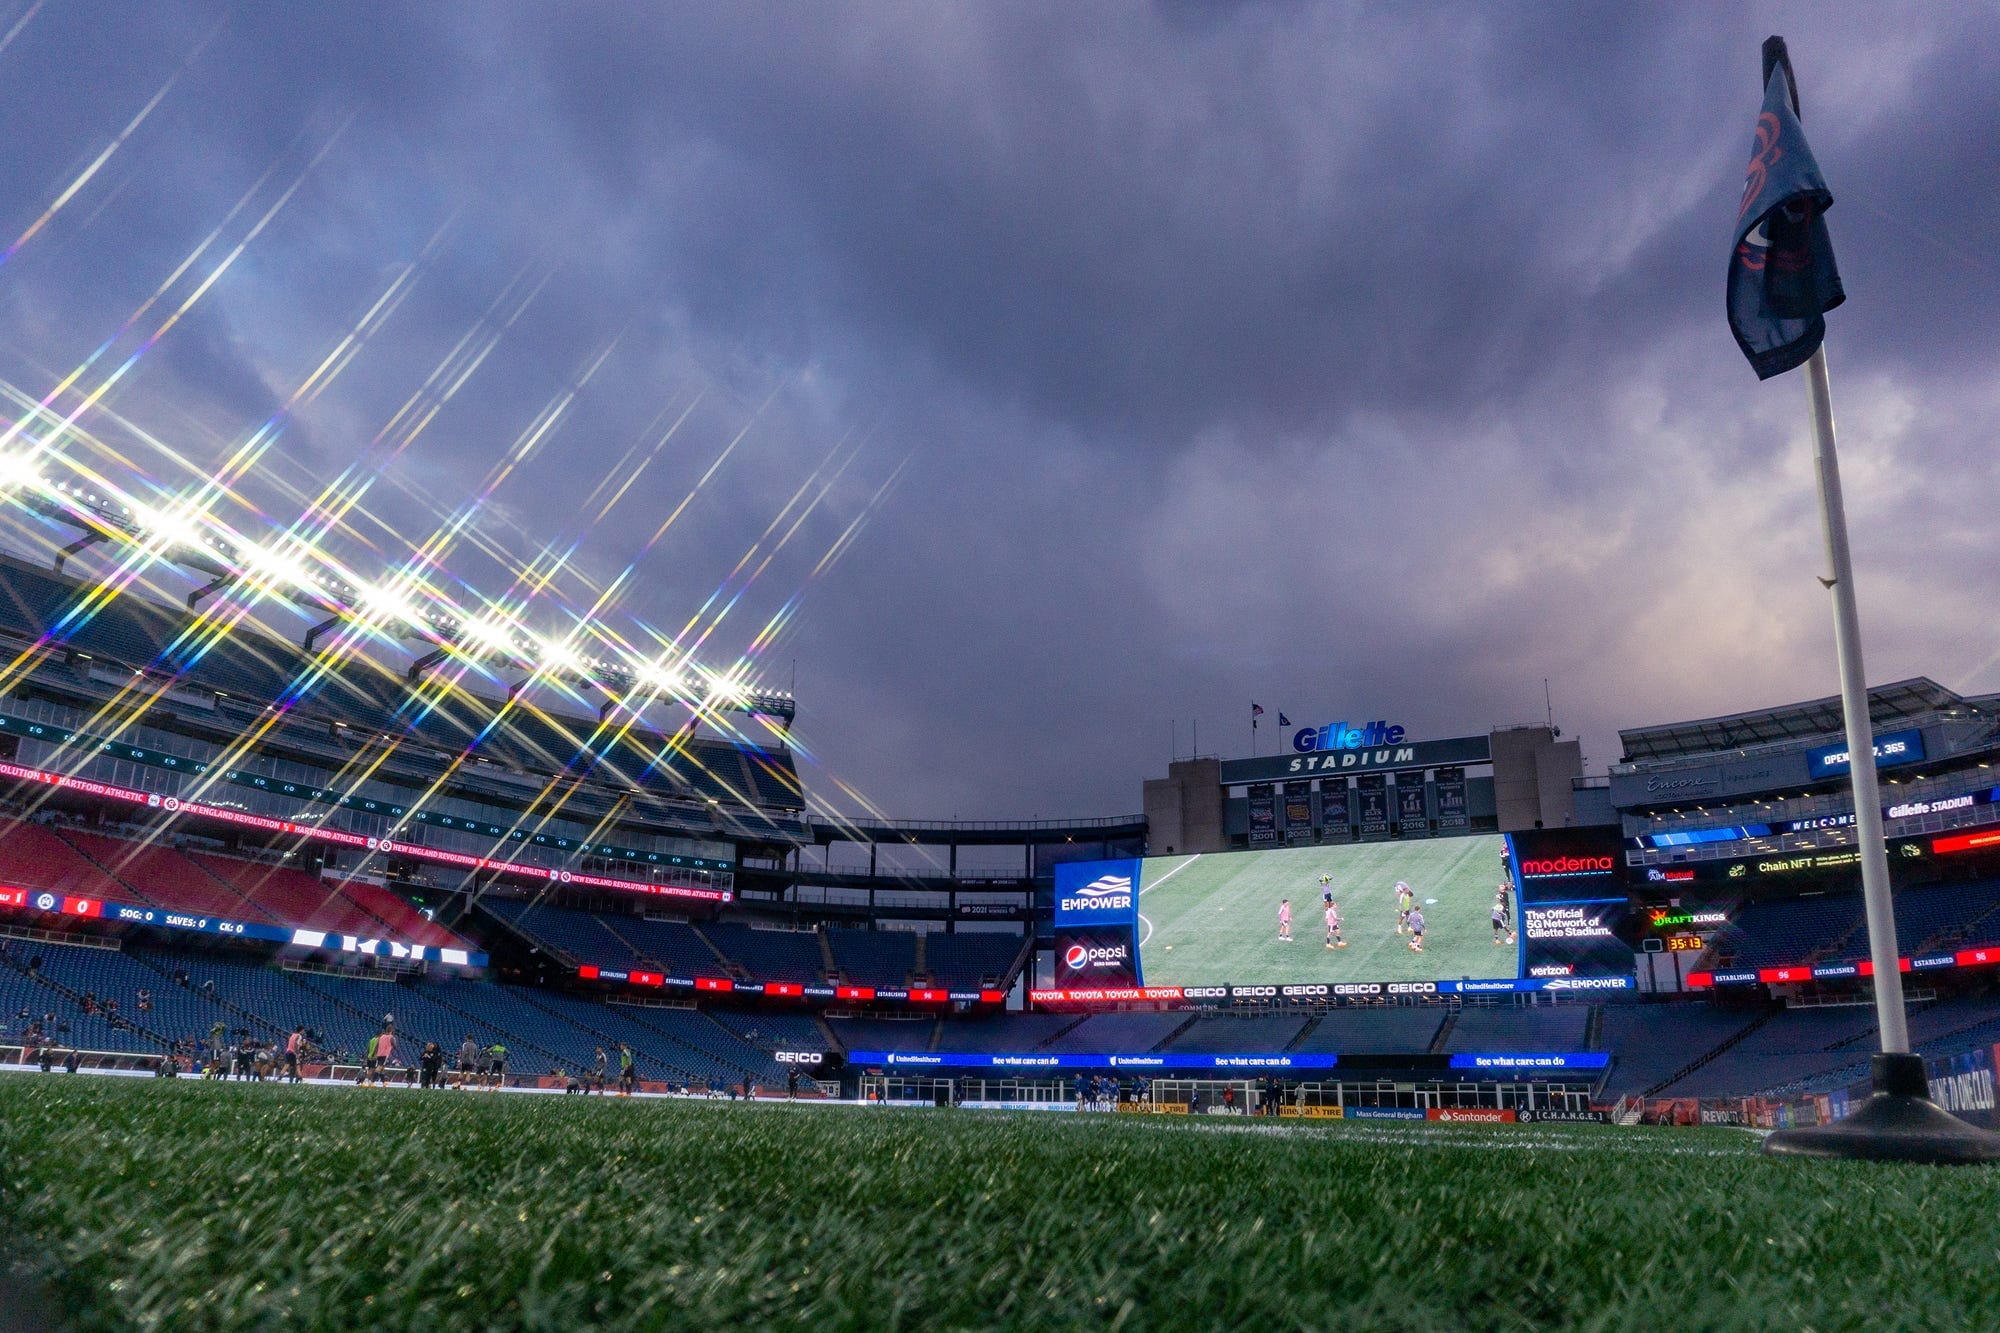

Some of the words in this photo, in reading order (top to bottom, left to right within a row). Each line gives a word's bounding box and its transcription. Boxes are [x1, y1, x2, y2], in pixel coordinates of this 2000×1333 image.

[1293, 721, 1405, 753] Gillette
[1884, 742, 1905, 754] 365
[1290, 748, 1414, 772] STADIUM
[0, 764, 40, 780] OLUTION
[58, 777, 104, 793] HARTFORD
[104, 788, 144, 802] ATHLETIC
[1648, 776, 1718, 792] Encore
[1889, 803, 1930, 818] Gillette
[1931, 796, 1973, 812] STADIUM
[180, 802, 197, 812] NEW
[200, 806, 234, 820] ENGLAND
[234, 814, 280, 829] REVOLUTION
[1402, 822, 1425, 830] 2016
[1793, 815, 1855, 830] WELCOME
[294, 826, 332, 839] HARTFORD
[332, 832, 363, 844] ATHLETIC
[393, 844, 409, 854] NEW
[409, 847, 438, 858] ENGLAND
[438, 852, 477, 865] REVOLUTION
[488, 861, 520, 872] HARTFORD
[520, 866, 548, 877] ATHLETIC
[1523, 857, 1611, 874] moderna
[1760, 861, 1789, 872] Chain
[1792, 858, 1813, 868] NFT
[572, 875, 585, 883] NEW
[585, 877, 613, 887] ENGLAND
[613, 881, 649, 892] REVOLUTION
[660, 887, 692, 896] HARTFORD
[692, 891, 719, 899] ATHLETIC
[77, 901, 88, 913] 0
[1062, 896, 1131, 911] EMPOWER
[120, 909, 143, 920] SOG:
[146, 912, 153, 921] 0
[972, 906, 988, 914] 2021
[1525, 910, 1546, 920] The
[1547, 908, 1583, 919] Official
[166, 916, 196, 928] SAVES:
[199, 919, 206, 928] 0
[1526, 920, 1543, 929] 5G
[1544, 918, 1587, 928] Network
[1588, 917, 1600, 926] of
[1654, 914, 1726, 926] DRAFTKINGS
[219, 922, 234, 932] CK:
[236, 924, 244, 933] 0
[1528, 928, 1564, 938] Gillette
[1565, 927, 1611, 937] Stadium.
[1671, 938, 1701, 950] 35:13
[1089, 945, 1125, 962] pepsi
[1914, 957, 1954, 967] ESTABLISHED
[1976, 953, 1986, 961] 96
[1531, 966, 1569, 976] verizon
[1715, 974, 1755, 982] ESTABLISHED
[1778, 971, 1789, 980] 96
[1814, 967, 1855, 976] ESTABLISHED
[1465, 983, 1514, 991] UnitedHealthcare
[1572, 979, 1626, 989] EMPOWER
[1032, 991, 1064, 1000] TOYOTA
[1070, 991, 1103, 999] TOYOTA
[1105, 990, 1139, 999] TOYOTA
[1145, 989, 1181, 998] TOYOTA
[1184, 988, 1226, 998] GEICO
[1232, 986, 1277, 997] GEICO
[1283, 985, 1328, 996] GEICO
[1334, 984, 1381, 995] GEICO
[1388, 983, 1436, 994] GEICO
[775, 1052, 822, 1063] GEICO
[896, 1056, 941, 1064] UnitedHealthcare
[993, 1057, 1005, 1065] See
[1006, 1057, 1022, 1065] what
[1050, 1057, 1059, 1065] do
[1118, 1057, 1163, 1065] UnitedHealthcare
[1229, 1057, 1249, 1065] what
[1281, 1057, 1291, 1065] do
[1476, 1057, 1492, 1066] See
[1493, 1057, 1515, 1066] what
[1516, 1058, 1534, 1066] care
[1536, 1058, 1551, 1066] can
[1553, 1057, 1565, 1065] do
[1323, 1108, 1341, 1116] TIRE
[1397, 1112, 1423, 1120] Brigham
[1453, 1112, 1502, 1121] Santander
